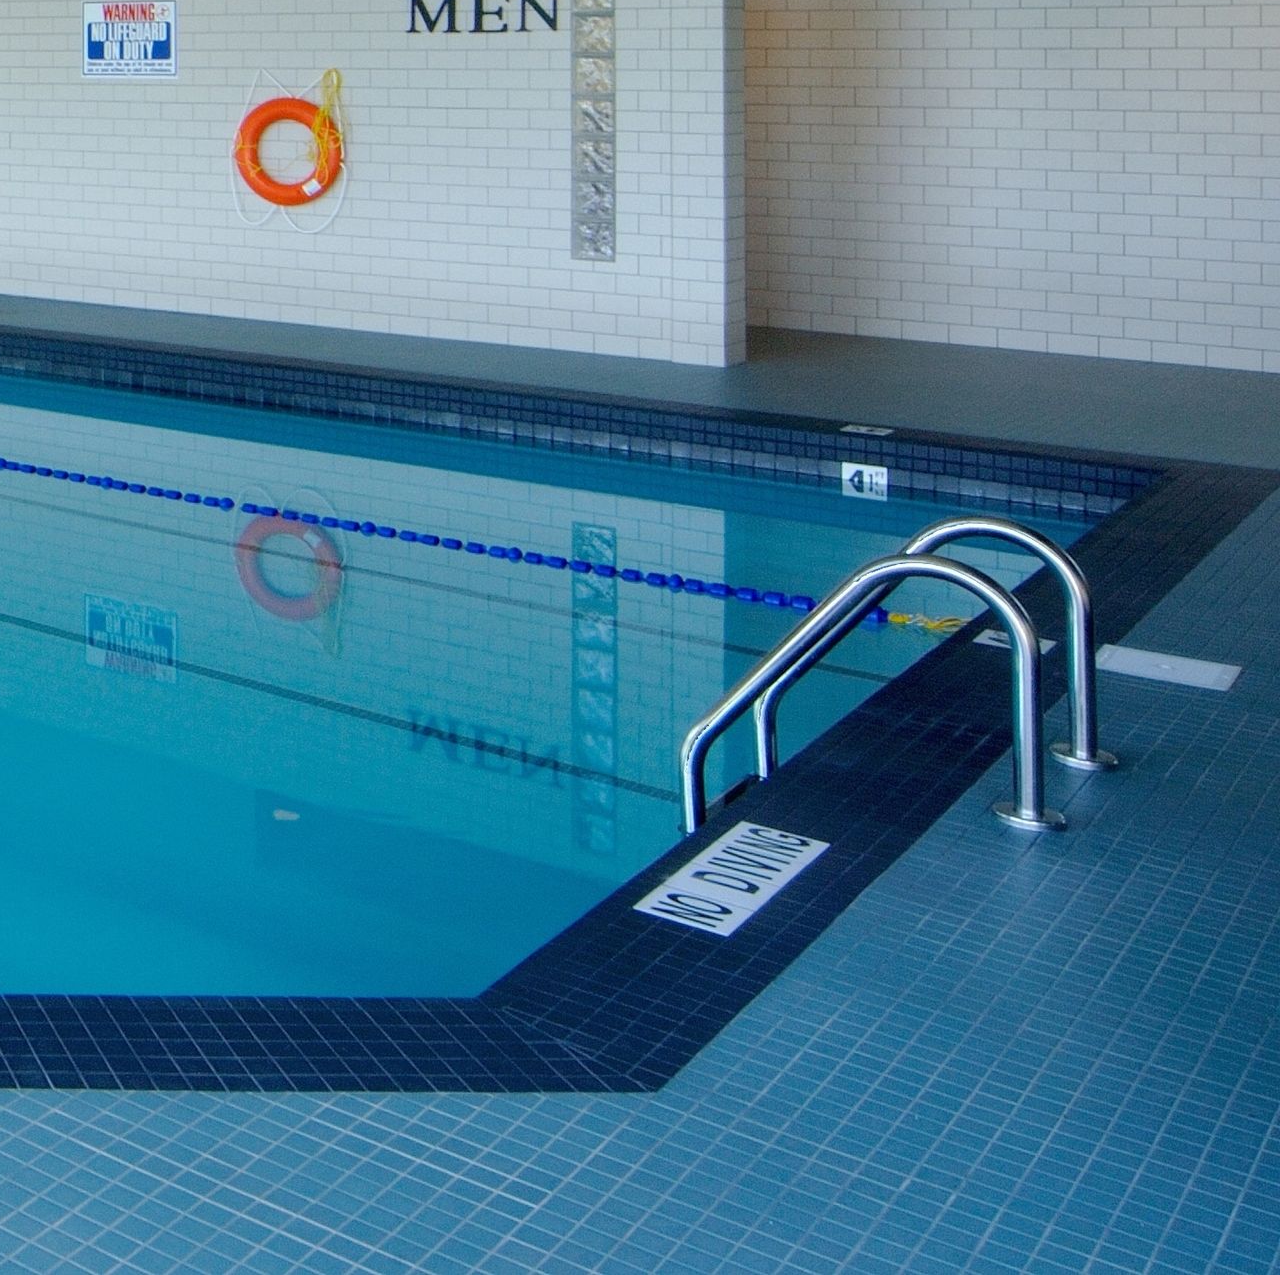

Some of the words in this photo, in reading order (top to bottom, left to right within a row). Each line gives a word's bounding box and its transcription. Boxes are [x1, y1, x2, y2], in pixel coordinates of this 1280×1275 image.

[103, 3, 155, 21] WARNING
[91, 23, 106, 42] NO
[108, 22, 167, 42] LIFEGUARD
[103, 41, 120, 60] ON
[123, 40, 153, 60] DUTY
[651, 893, 733, 928] NO
[692, 828, 811, 895] DIVING
